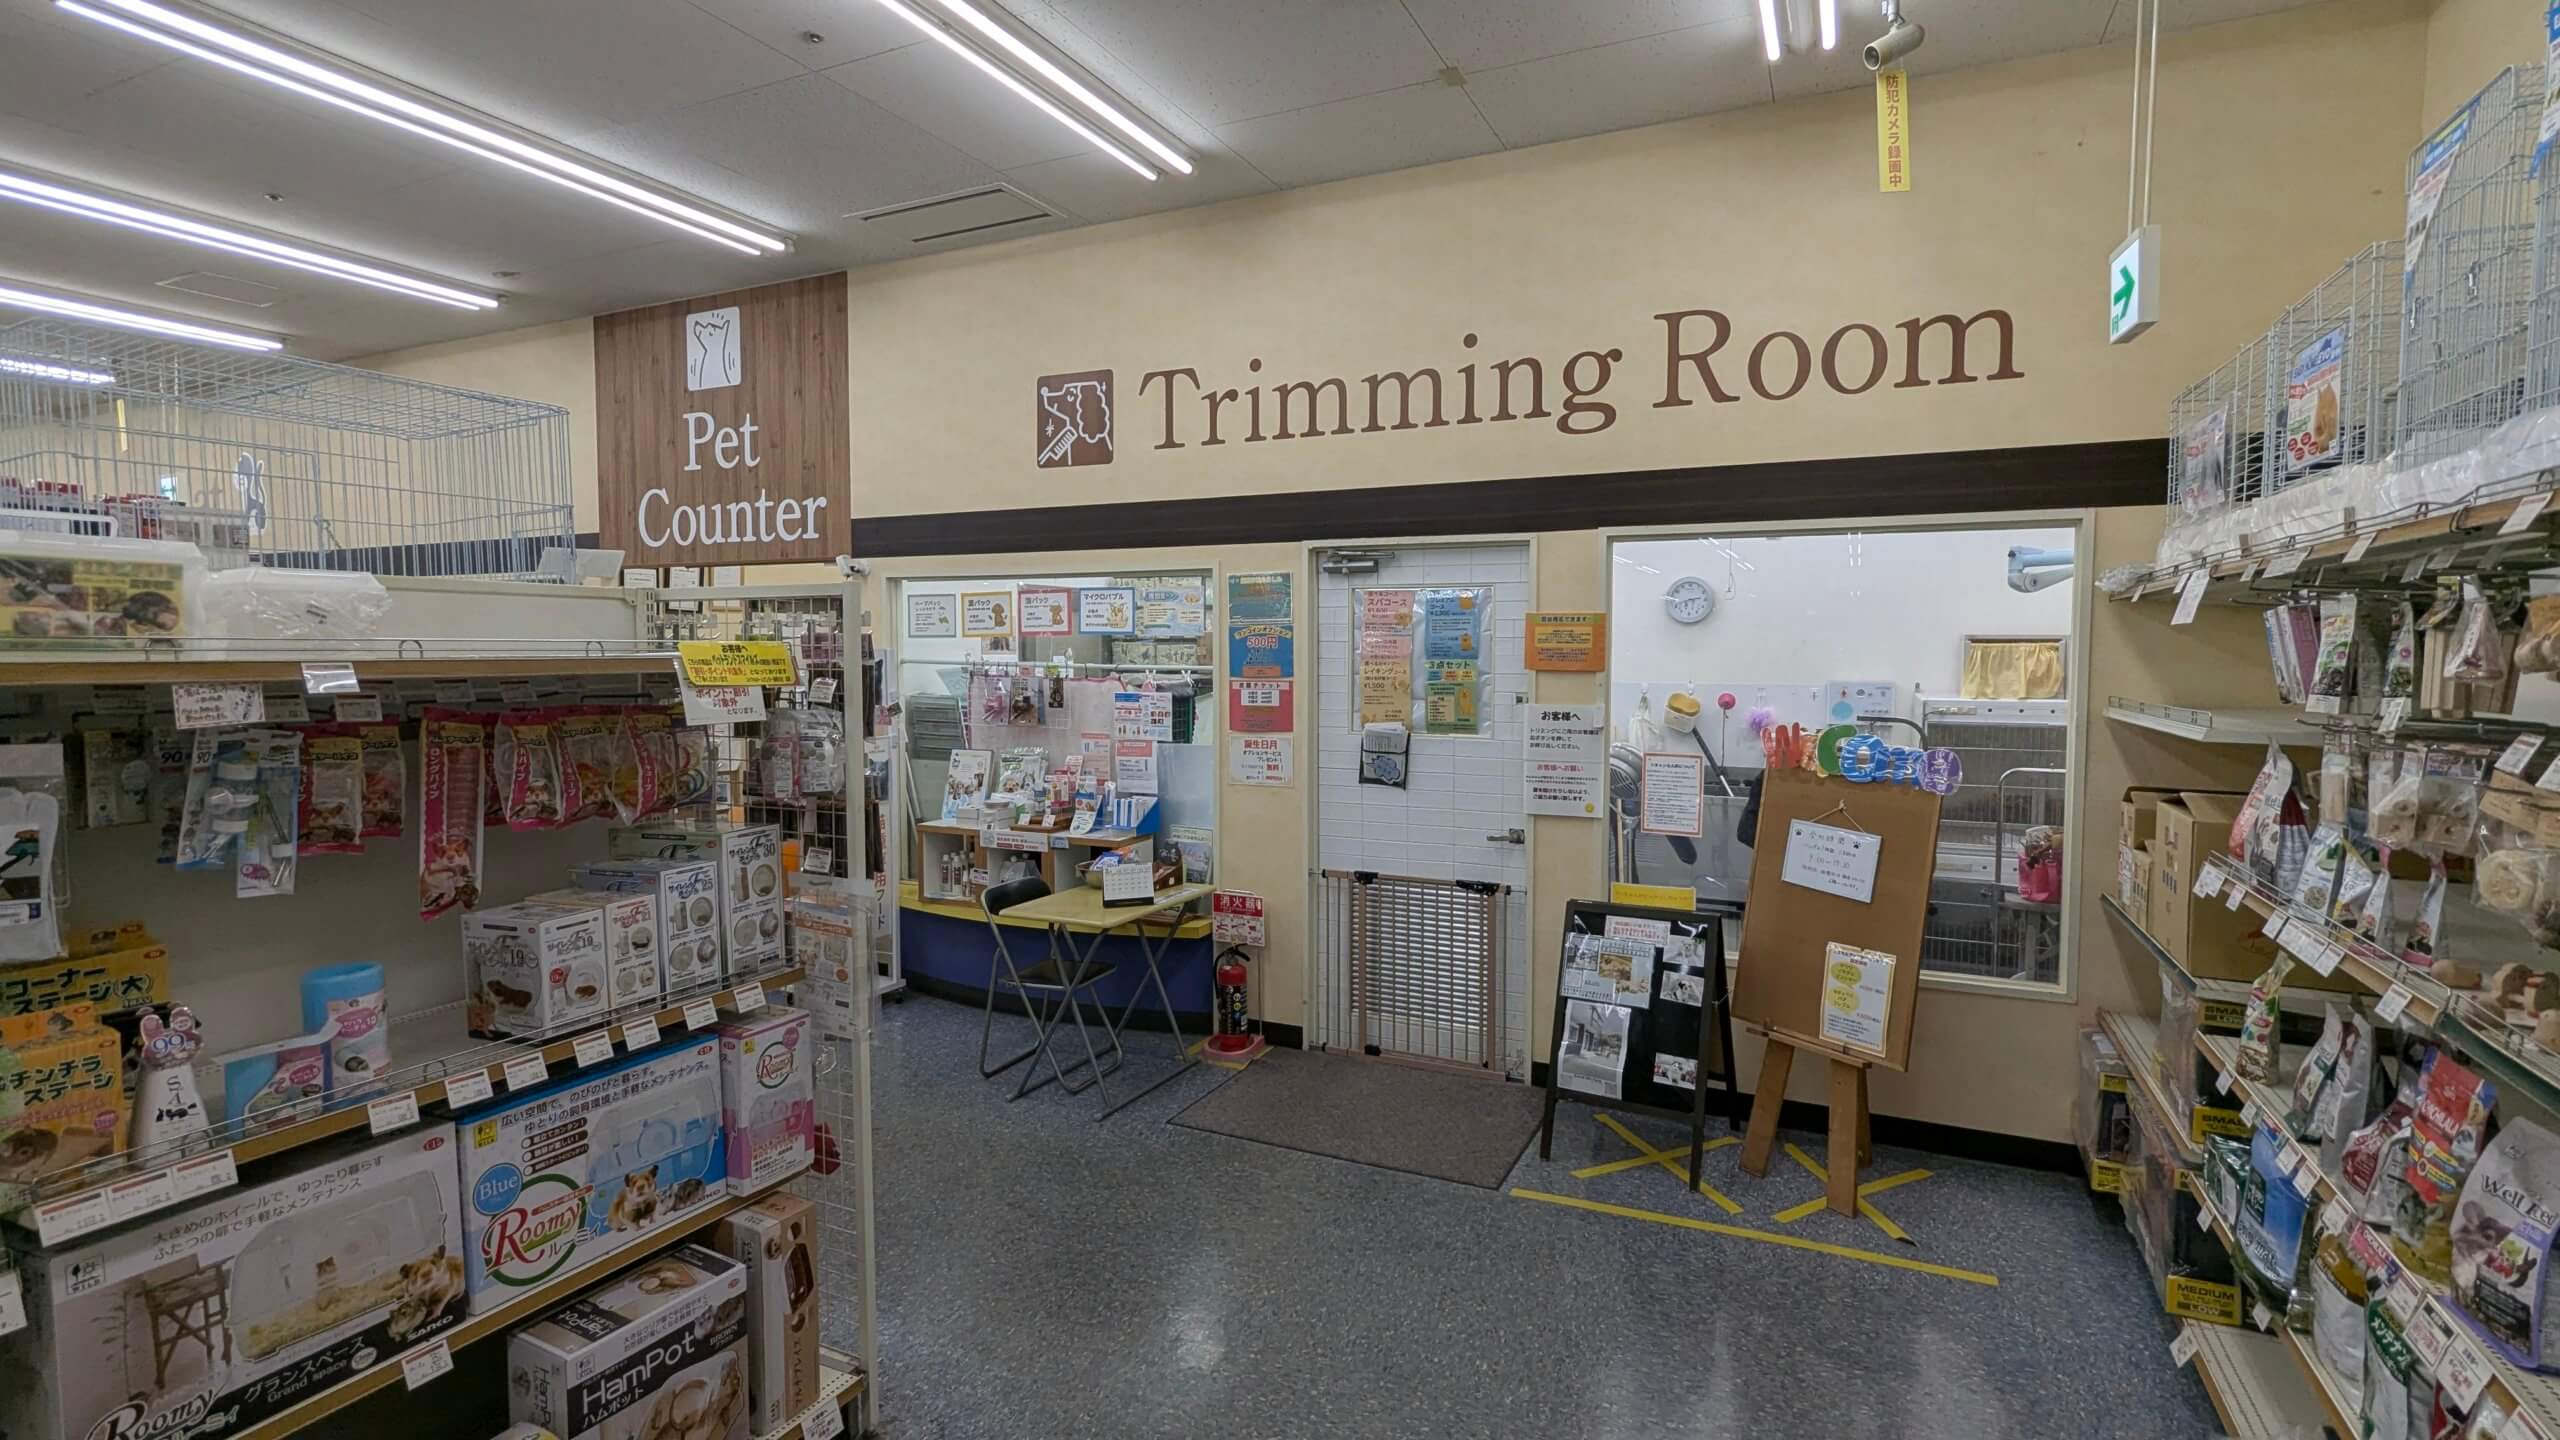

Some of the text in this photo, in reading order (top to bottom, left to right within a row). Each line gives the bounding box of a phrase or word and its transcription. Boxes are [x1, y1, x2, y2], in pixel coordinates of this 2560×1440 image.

[1886, 75, 1902, 187] 防犯カメラ録画中
[1139, 308, 2026, 449] Trimming Room
[683, 412, 760, 471] Pet
[639, 488, 827, 548] Counter
[1246, 636, 1279, 649] 500円
[696, 687, 750, 699] ポイント・割引
[1541, 711, 1581, 721] お客様へ
[1244, 739, 1278, 749] 誕生日月
[5, 966, 107, 1000] コーナー
[10, 1054, 104, 1090] チンチラ
[24, 1072, 115, 1106] ステージ
[152, 1155, 385, 1245] 大きめのホイールで、ゆったり暮らす
[479, 1174, 519, 1197] Blue
[154, 1179, 363, 1262] ふたつの扉で手軽なメンテナンス
[482, 1202, 581, 1279] Roomy
[547, 1226, 601, 1260] ルーミィ
[2177, 1283, 2235, 1301] MEDIUM
[245, 1335, 367, 1402] グランスペース
[580, 1330, 697, 1415] HamPot
[86, 1388, 217, 1440] Roomy
[582, 1387, 644, 1429] ハムポット
